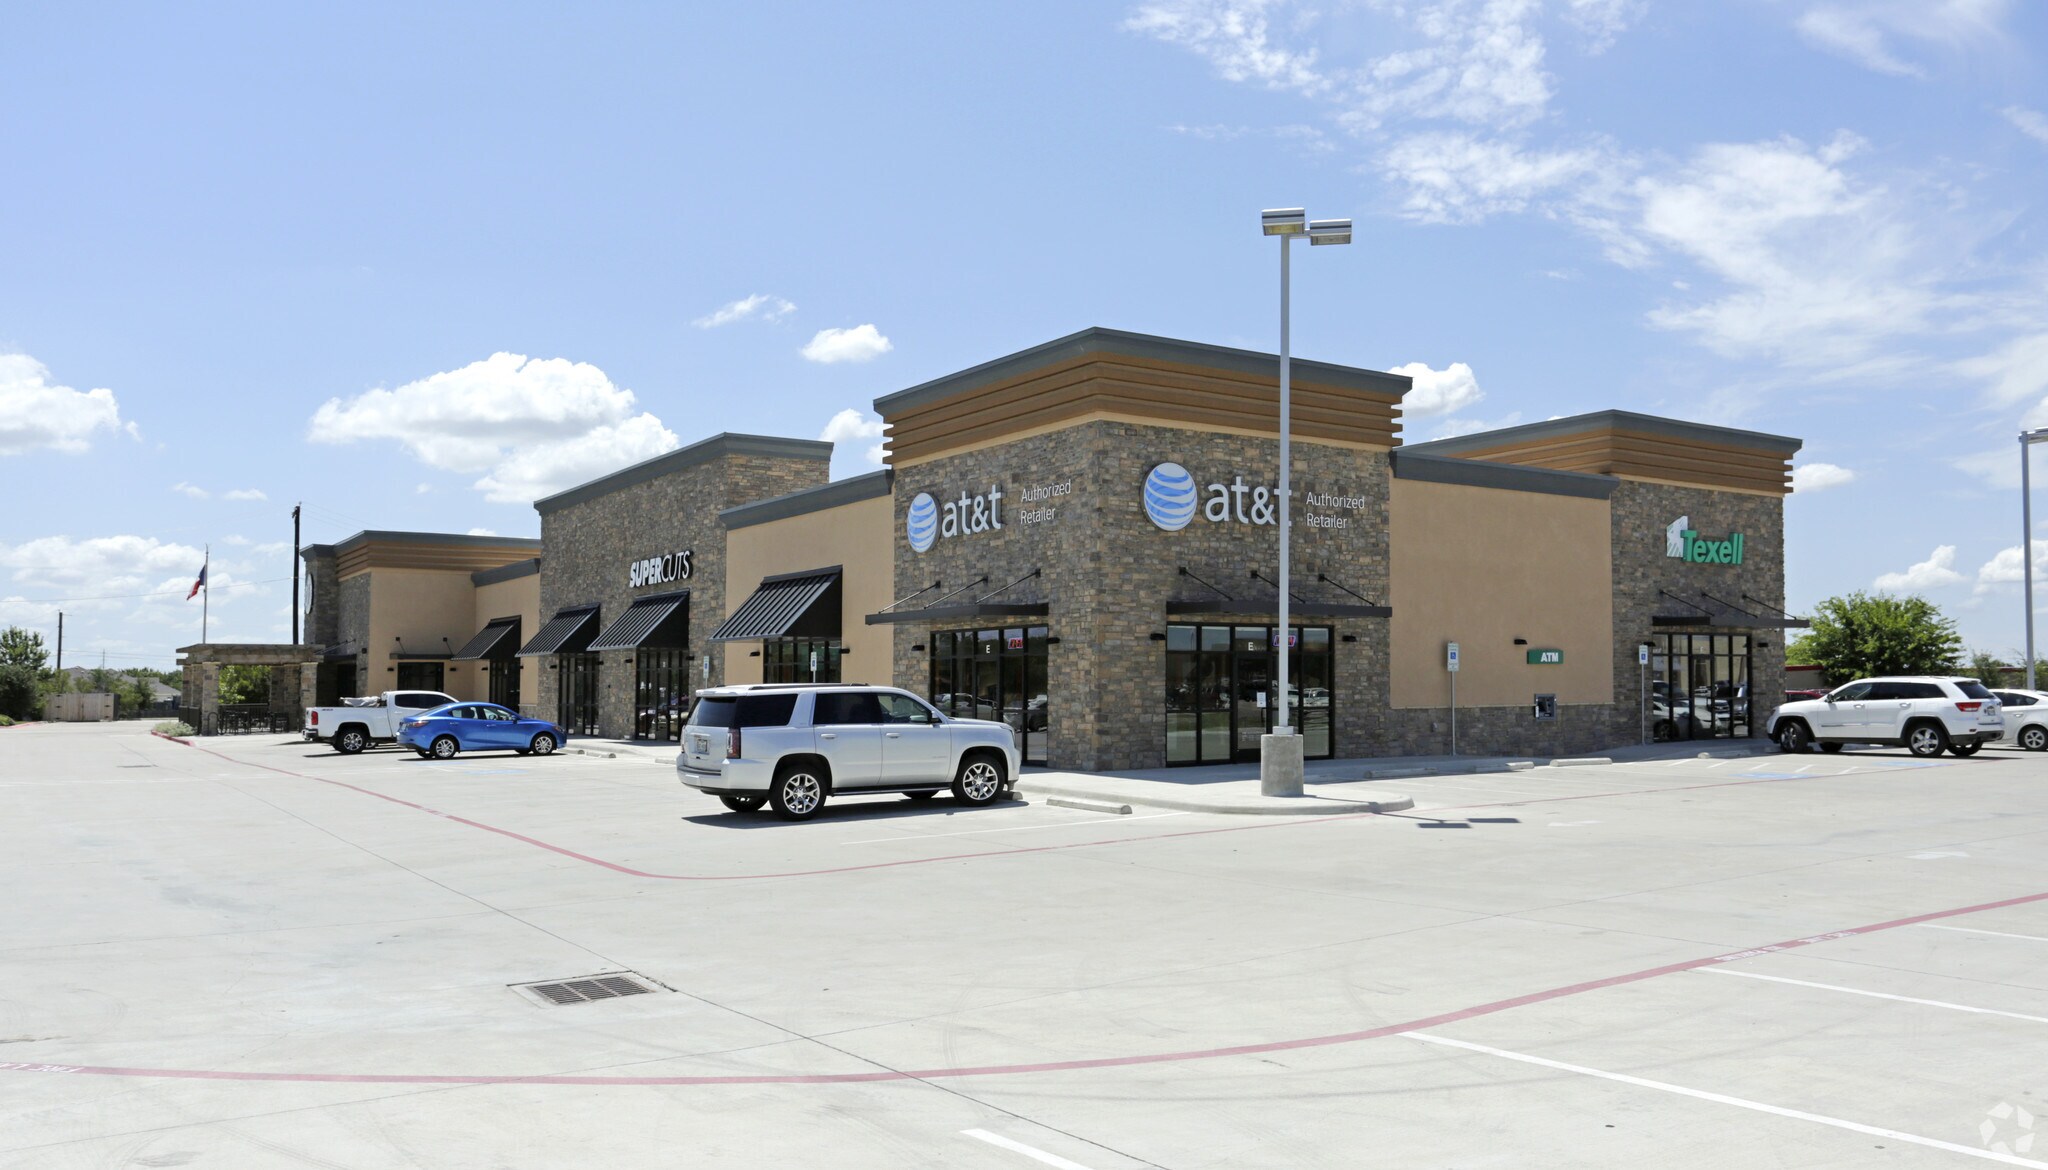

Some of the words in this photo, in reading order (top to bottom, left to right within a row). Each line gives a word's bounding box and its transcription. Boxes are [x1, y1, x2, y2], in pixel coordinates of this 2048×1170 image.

[1020, 479, 1072, 503] Authorized
[1306, 491, 1365, 510] Authorized
[942, 484, 1002, 538] at&t
[1020, 507, 1056, 525] Retailer
[1306, 513, 1348, 529] Retailer
[1680, 530, 1744, 565] Texell
[629, 550, 691, 588] SUPERCUTS
[1540, 652, 1559, 663] ATM
